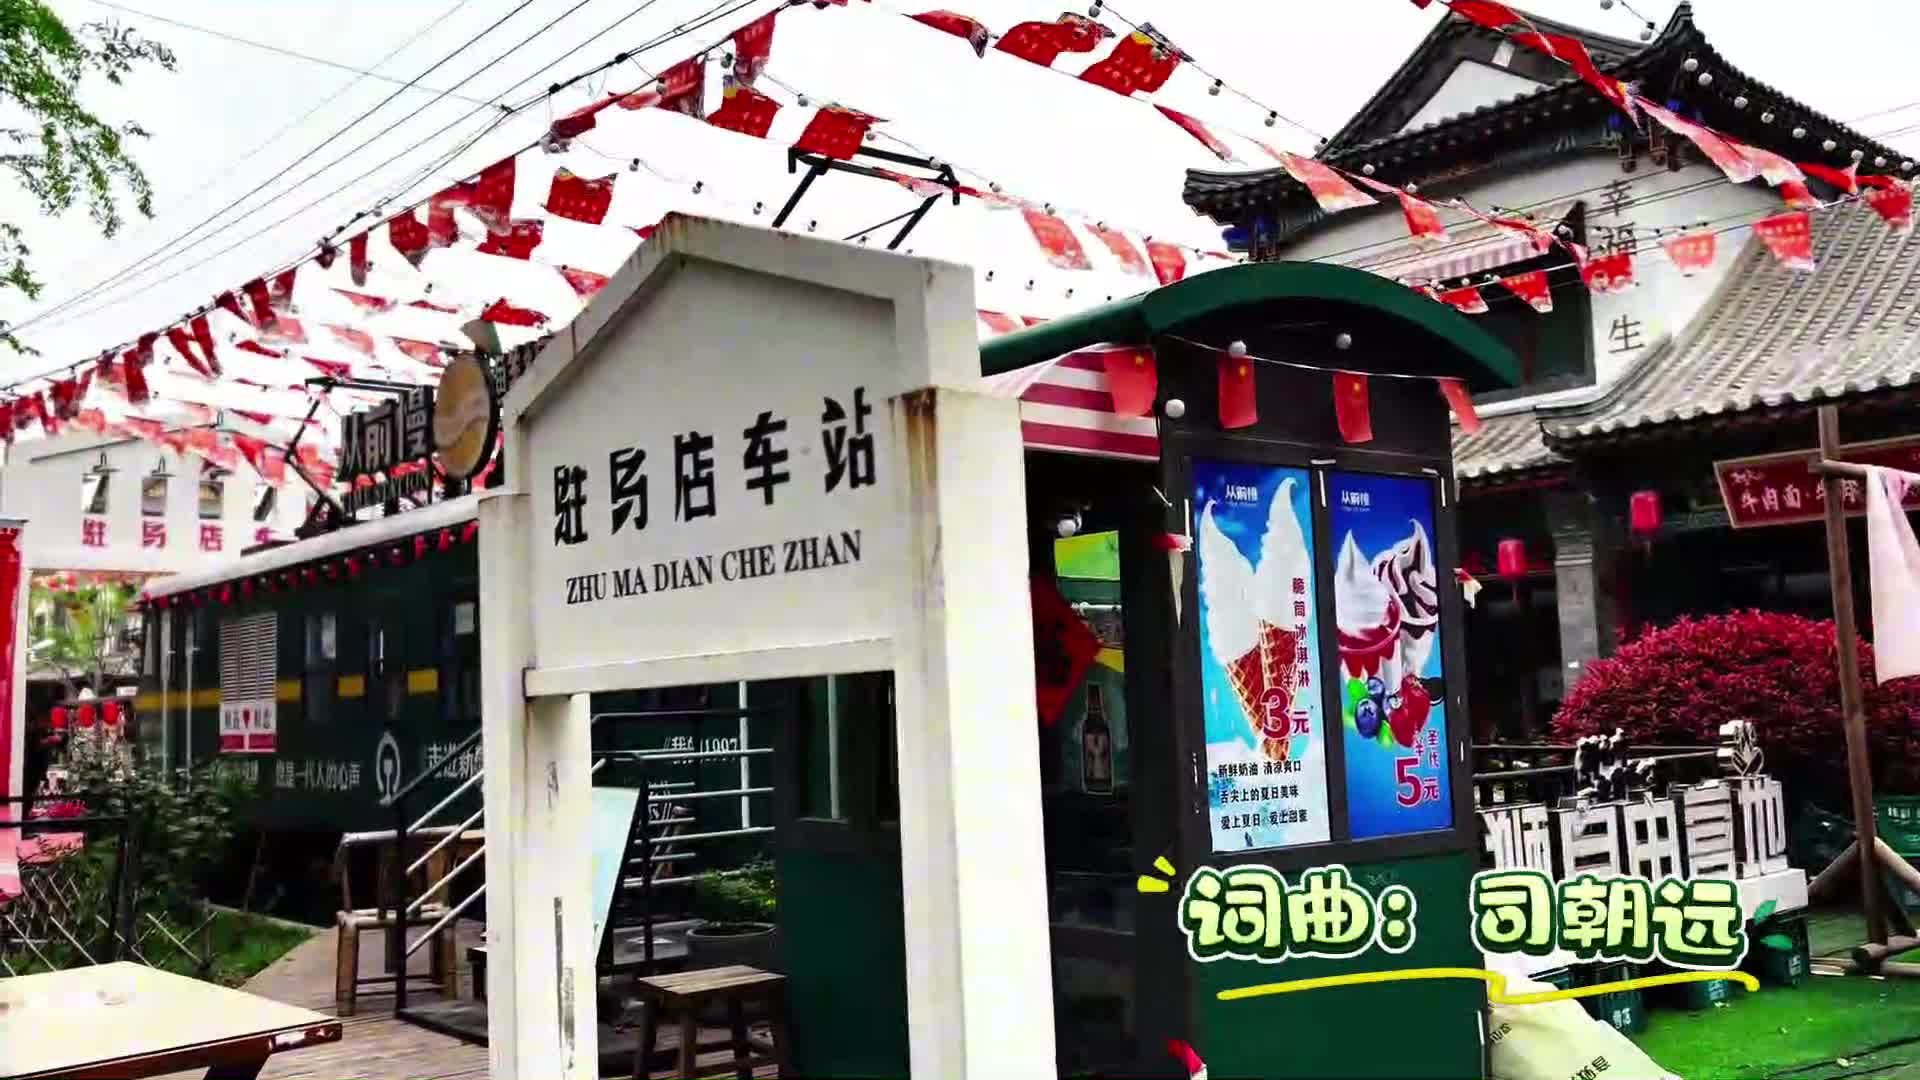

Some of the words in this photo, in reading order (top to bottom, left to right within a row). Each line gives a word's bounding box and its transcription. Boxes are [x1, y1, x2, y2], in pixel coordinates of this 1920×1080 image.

[1599, 179, 1647, 355] 幸福生
[554, 386, 877, 548] 驻马店车站
[566, 572, 607, 604] ZHU
[613, 564, 648, 598] MA
[653, 555, 714, 592] DIAN
[720, 544, 776, 582] CHE
[783, 529, 862, 575] ZHAN
[1292, 577, 1310, 688] 脆筒冰淇淋
[1218, 761, 1258, 778] 新鲜奶油
[1263, 760, 1302, 775] 清凉爽口
[1427, 729, 1440, 768] 圣代
[1220, 785, 1299, 803] 舌尖上的夏日美味
[1220, 813, 1261, 830] 爱上夏日
